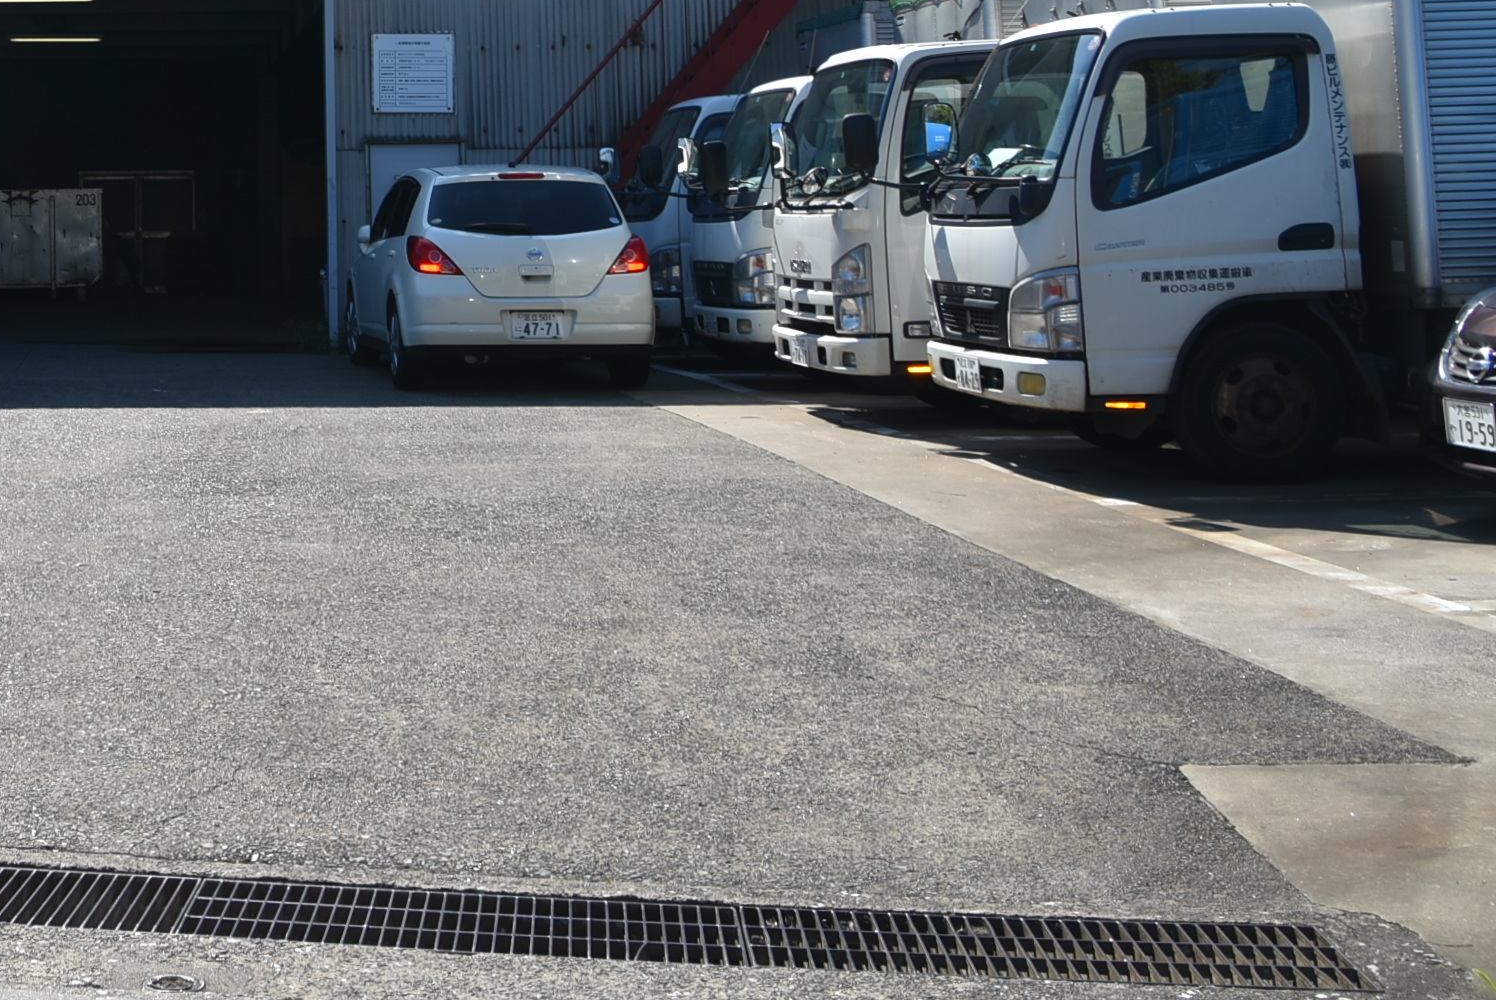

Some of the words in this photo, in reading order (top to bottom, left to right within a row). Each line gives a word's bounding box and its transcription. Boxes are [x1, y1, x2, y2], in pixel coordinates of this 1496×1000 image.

[75, 193, 96, 206] 203
[523, 322, 559, 336] 47-71
[1458, 419, 1495, 448] 19-59
